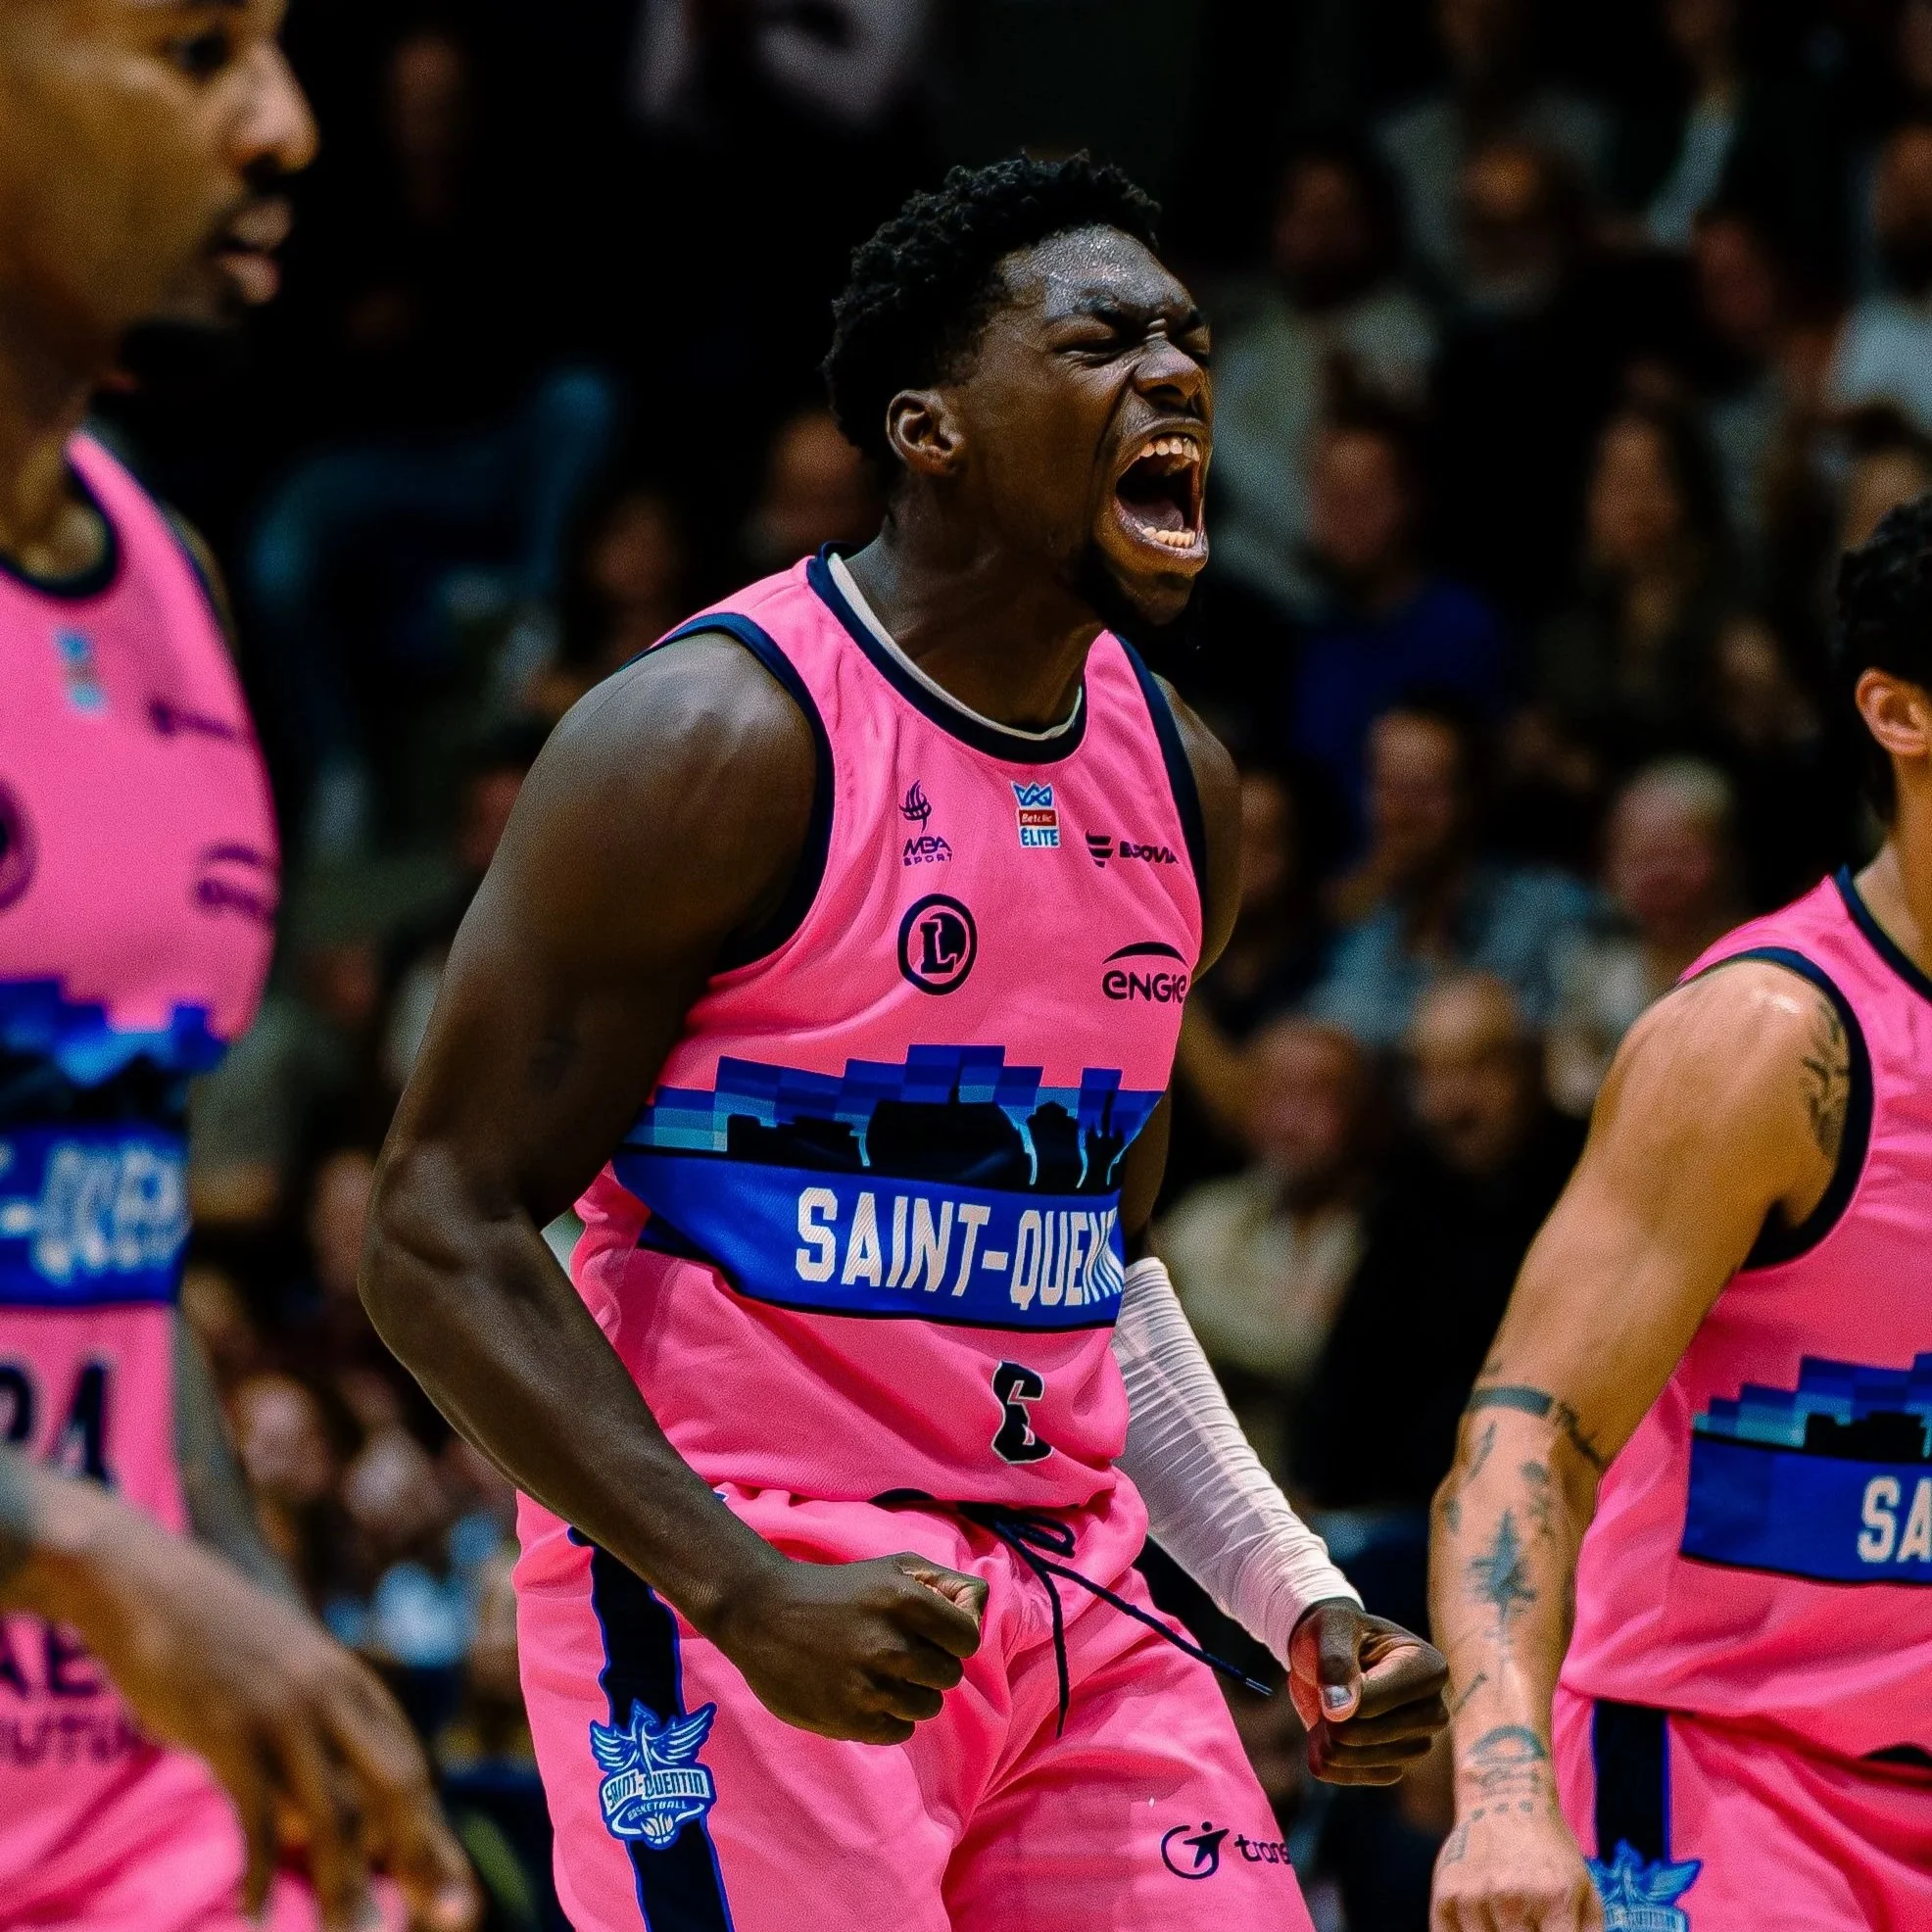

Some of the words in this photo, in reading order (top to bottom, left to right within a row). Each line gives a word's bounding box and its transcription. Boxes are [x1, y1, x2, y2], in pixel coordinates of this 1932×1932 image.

[902, 836, 952, 856] MBA
[903, 852, 952, 866] SPORT
[796, 1186, 1125, 1311] SAINT-QUEN
[627, 1800, 688, 1821] BASKETBALL
